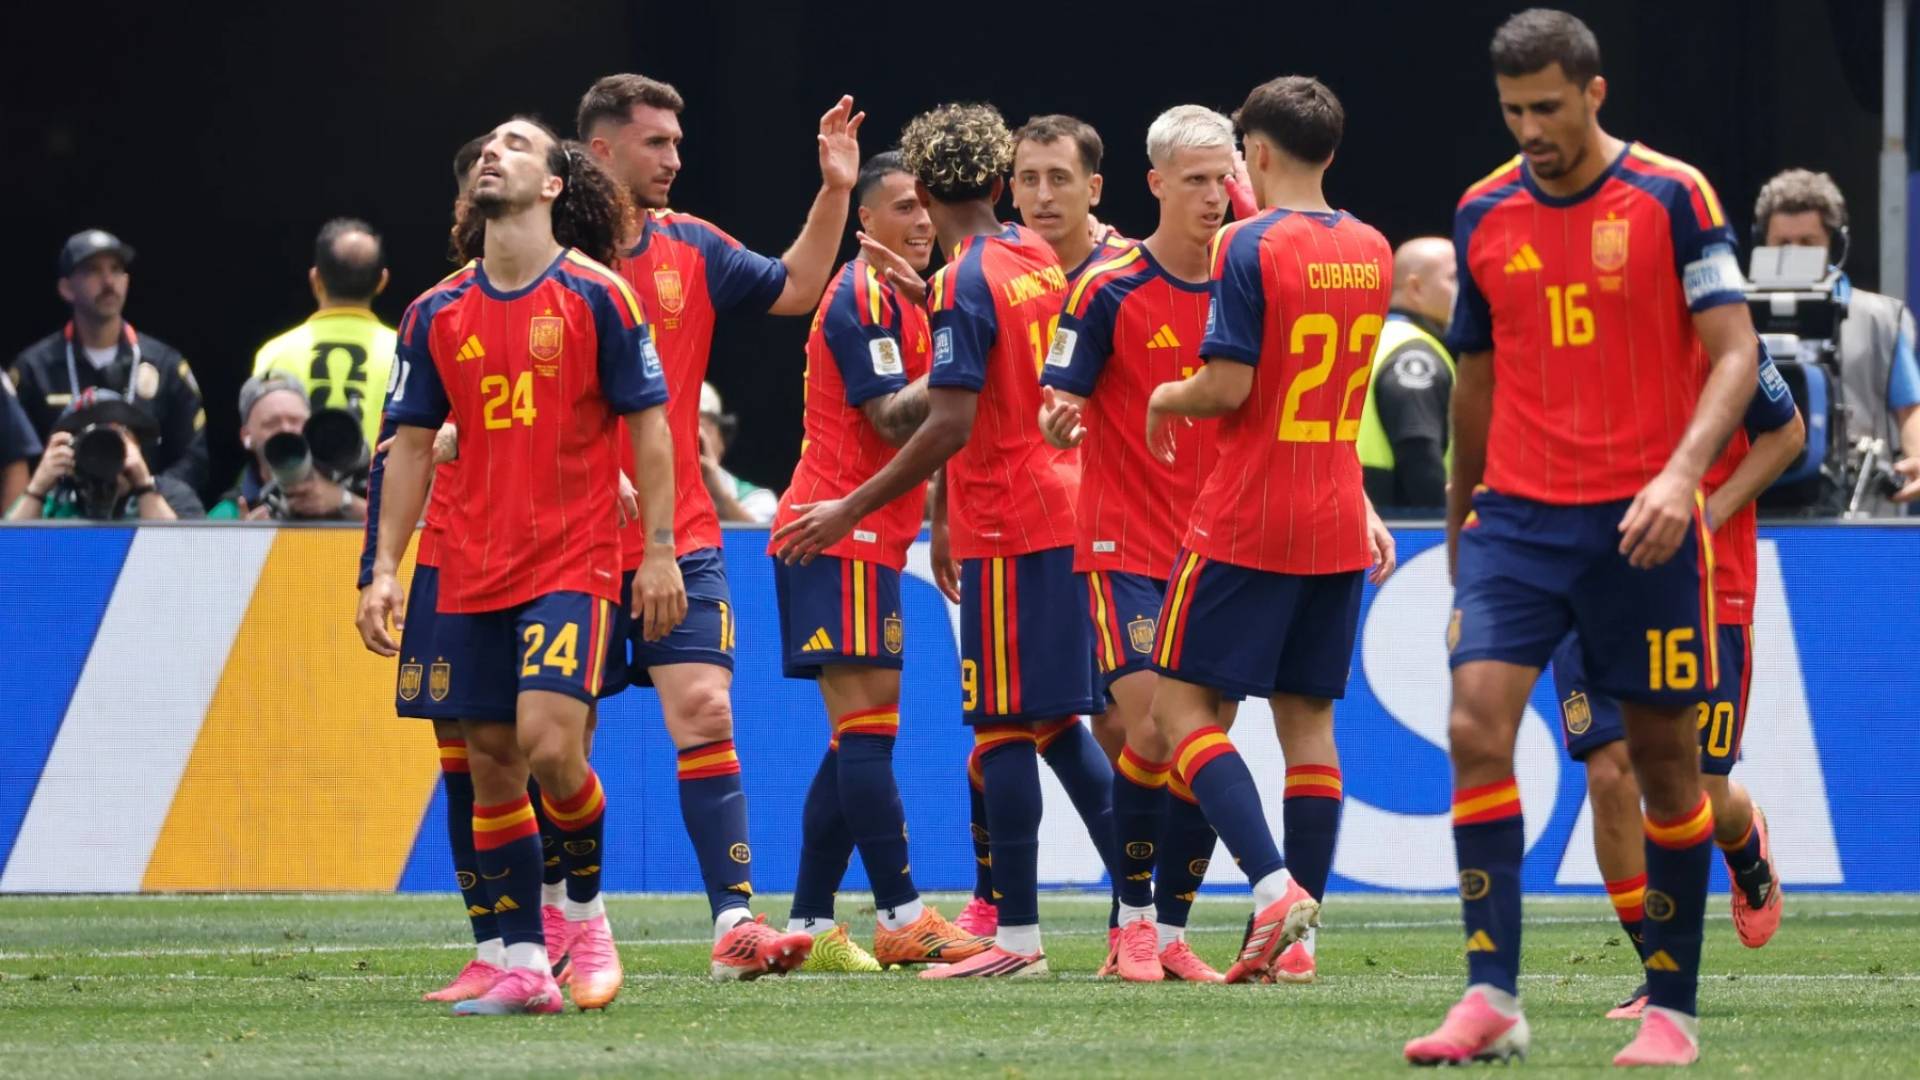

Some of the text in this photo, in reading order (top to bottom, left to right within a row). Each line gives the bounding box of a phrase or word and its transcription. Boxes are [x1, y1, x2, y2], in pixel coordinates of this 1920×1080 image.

[1307, 257, 1380, 290] CUBARSÍ
[1545, 283, 1595, 349] 16
[480, 371, 538, 430] 24
[1278, 313, 1385, 443] 22
[521, 622, 579, 678] 24
[1646, 627, 1699, 691] 16
